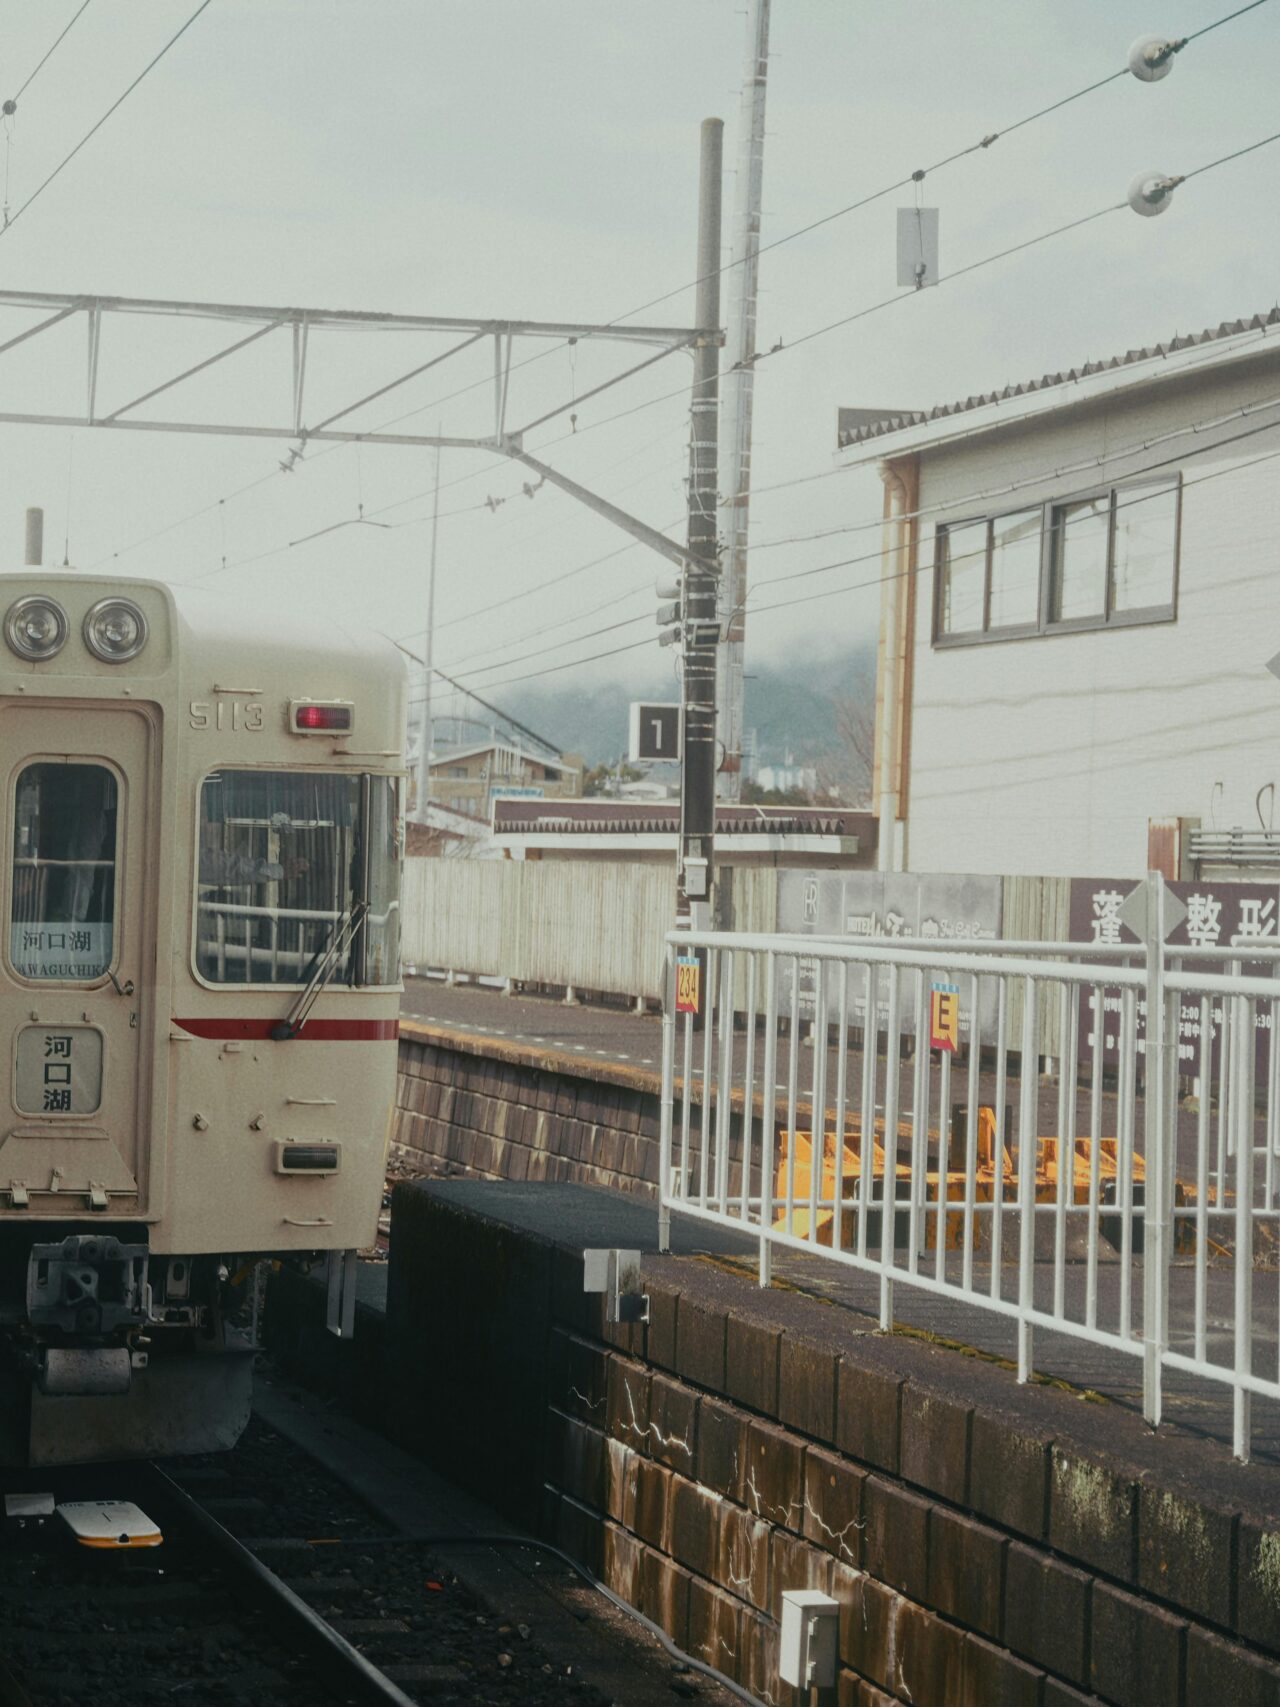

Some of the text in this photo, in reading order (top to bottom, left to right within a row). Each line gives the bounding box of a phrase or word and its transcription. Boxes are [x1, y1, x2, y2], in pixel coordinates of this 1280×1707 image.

[189, 701, 265, 731] 5113
[651, 719, 662, 750] 1
[23, 930, 92, 952] 河口湖
[13, 963, 110, 977] AWAGUCHIK
[679, 967, 696, 999] 234
[938, 993, 951, 1031] E
[43, 1036, 72, 1112] 河口湖
